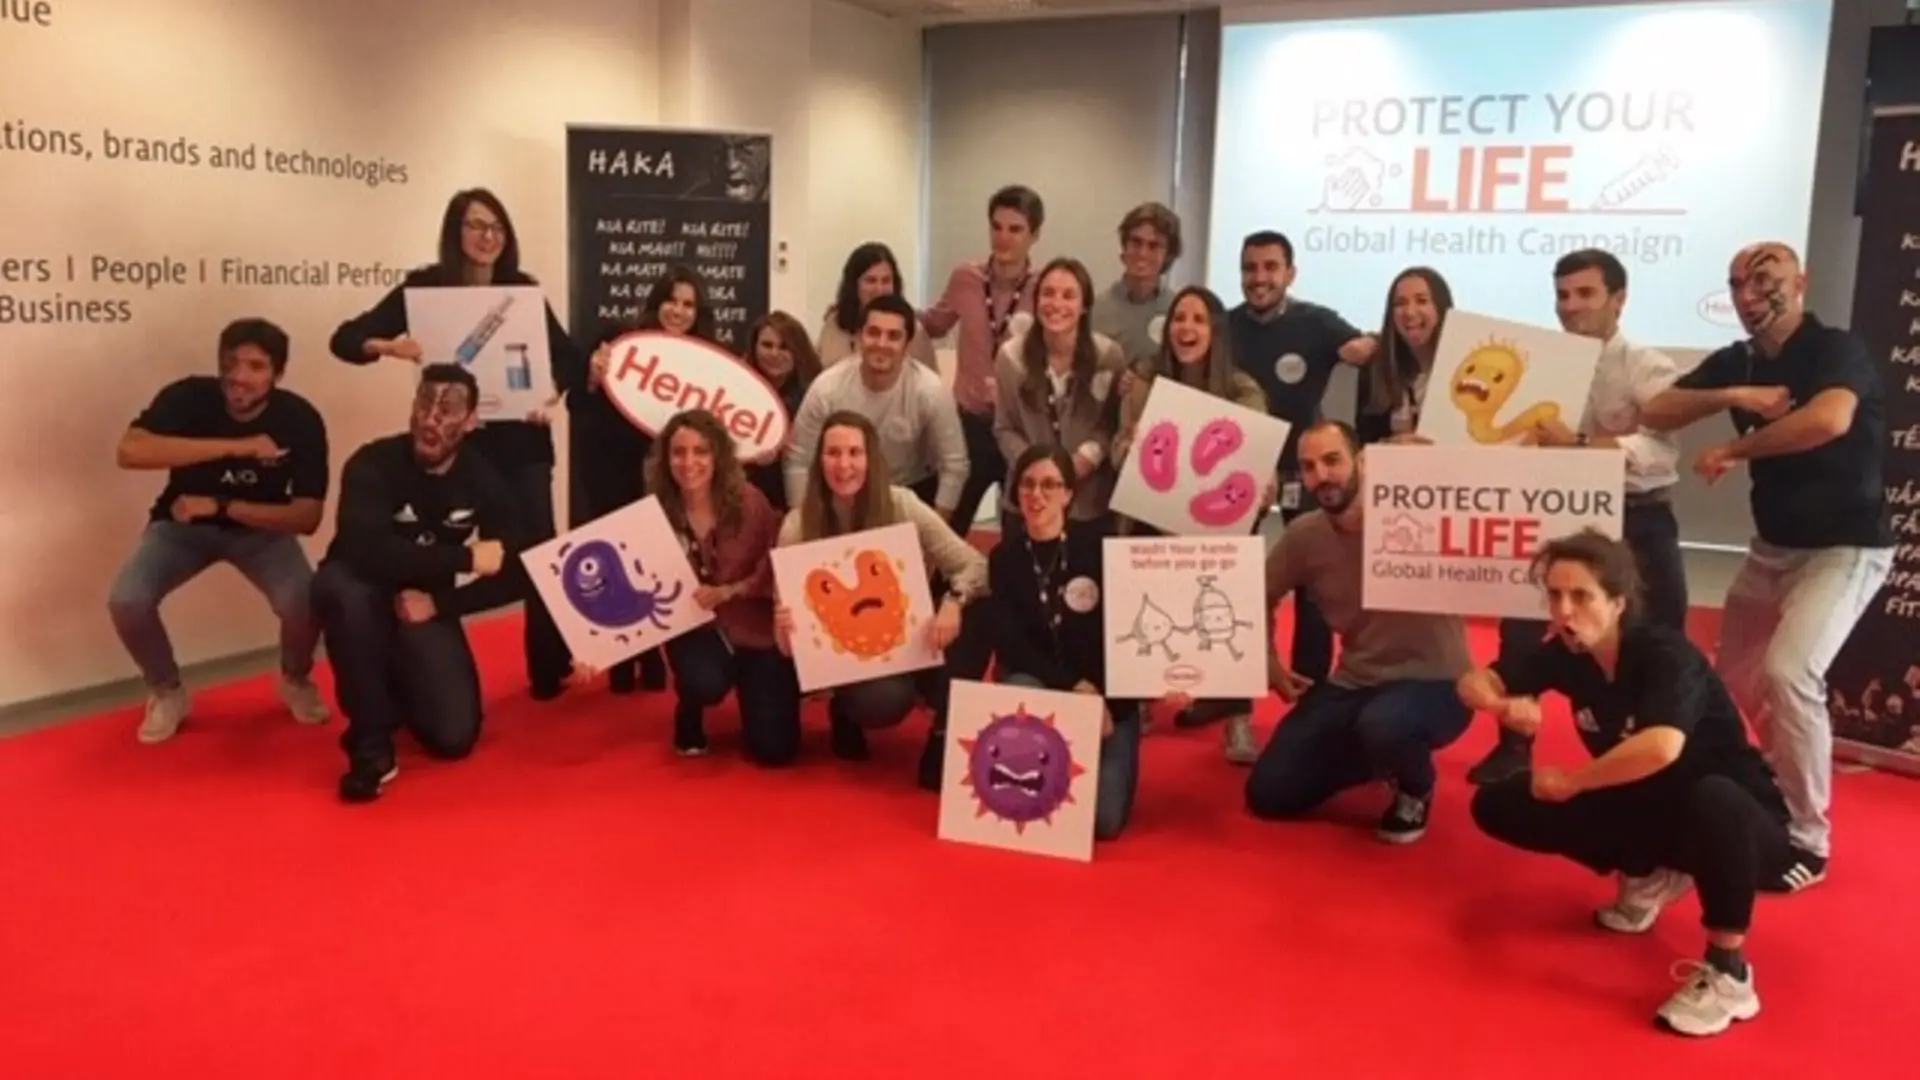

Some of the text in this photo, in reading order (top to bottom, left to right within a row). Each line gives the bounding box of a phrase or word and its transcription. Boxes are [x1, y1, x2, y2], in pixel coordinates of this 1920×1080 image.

[1311, 91, 1696, 137] PROTECT YOUR
[0, 118, 409, 188] tions, brands and technologies
[588, 148, 675, 179] HAKA
[1410, 145, 1573, 213] LIFE
[1304, 226, 1684, 263] Global Health Campaign
[91, 254, 187, 289] People
[221, 257, 329, 286] Financial
[337, 261, 408, 287] Perfor
[0, 292, 132, 324] Business
[615, 345, 775, 446] Henkel
[1372, 484, 1614, 516] PROTECT YOUR
[1439, 516, 1541, 560] LIFE
[1131, 557, 1170, 569] before
[1174, 559, 1196, 571] you
[1372, 559, 1432, 580] Global
[1439, 562, 1503, 584] Health
